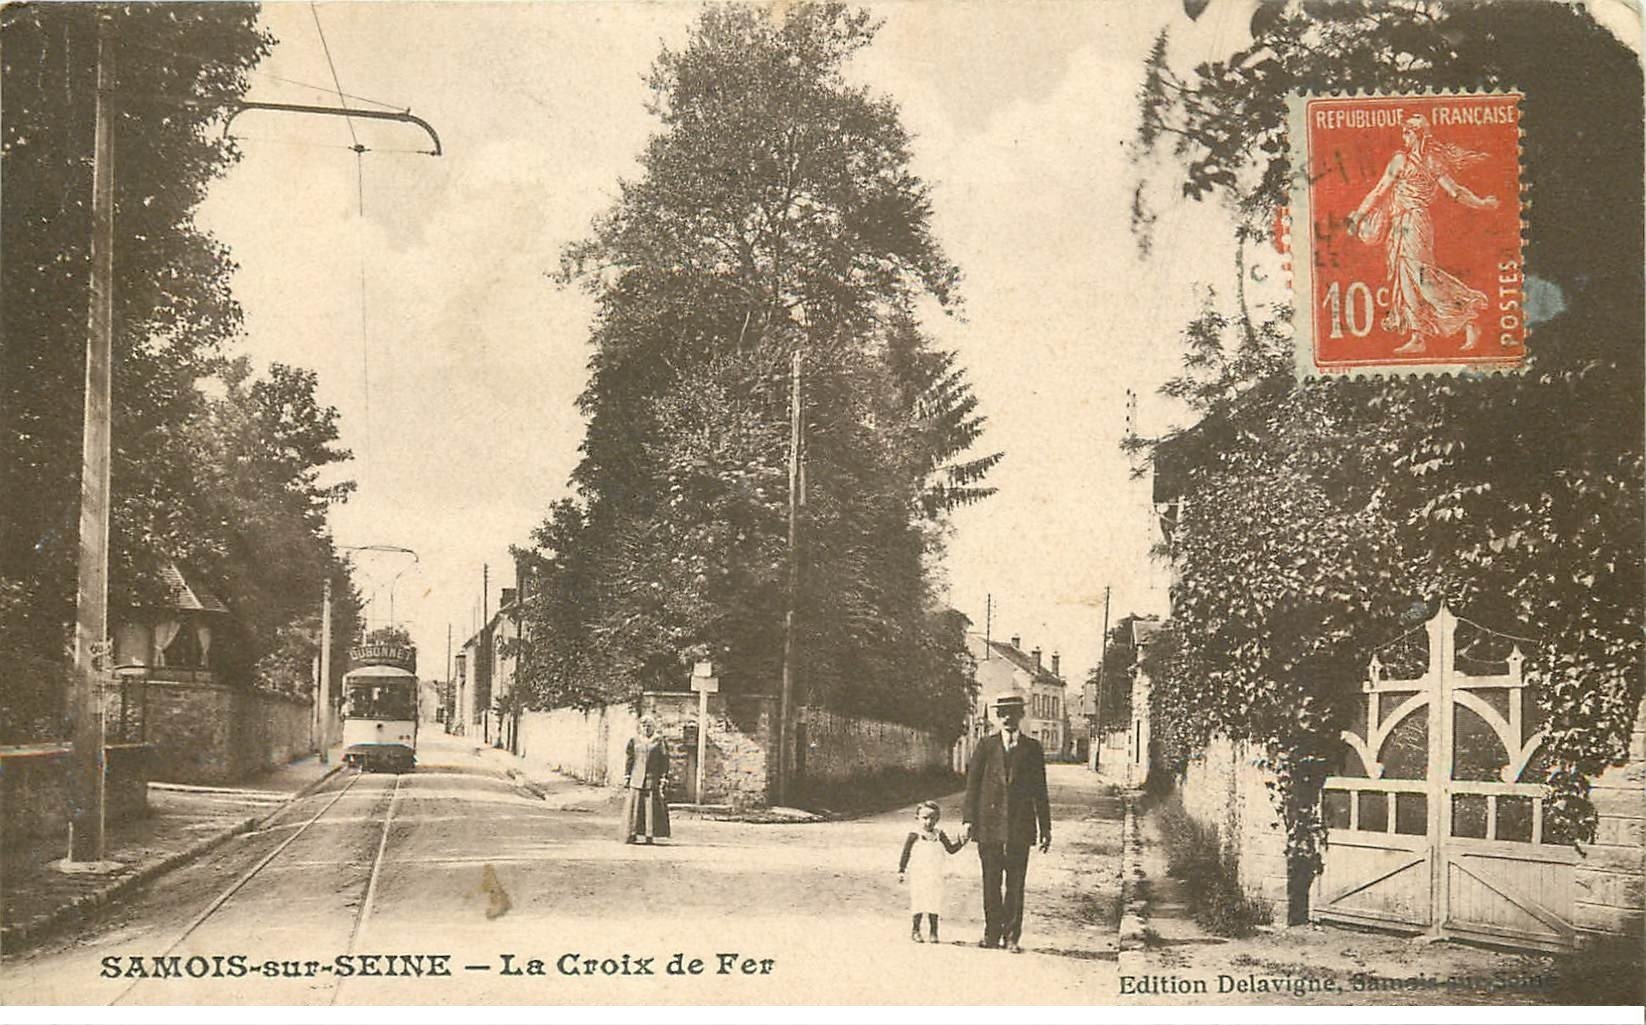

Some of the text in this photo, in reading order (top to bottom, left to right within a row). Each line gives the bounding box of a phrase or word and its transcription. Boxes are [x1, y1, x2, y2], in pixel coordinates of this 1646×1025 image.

[1432, 105, 1515, 126] FRANÇAISE
[1498, 260, 1519, 348] POSTES
[349, 646, 411, 661] DUBONNET
